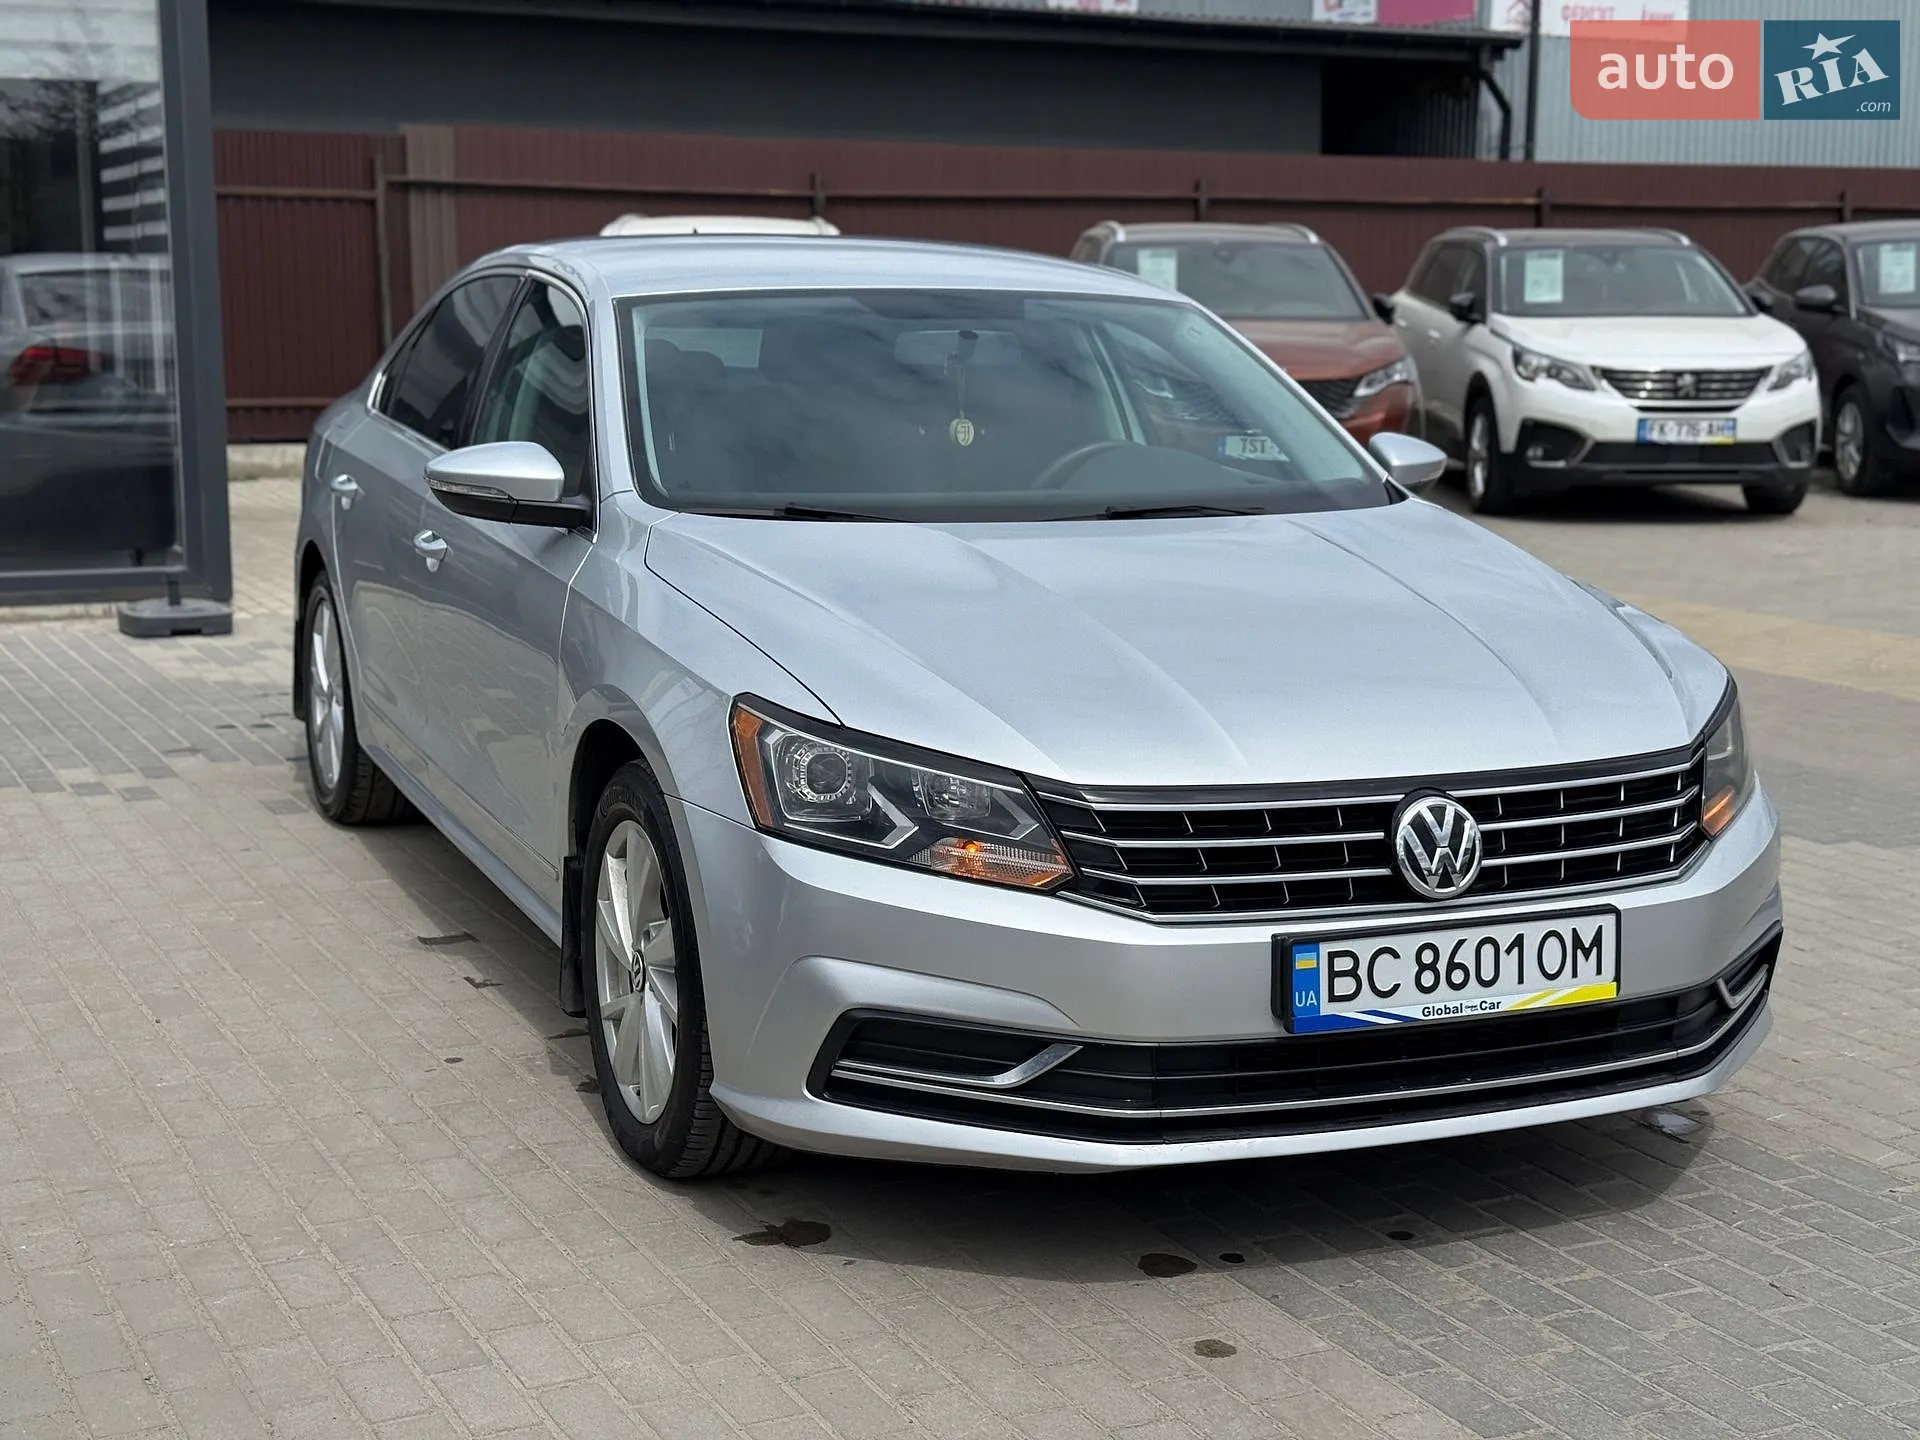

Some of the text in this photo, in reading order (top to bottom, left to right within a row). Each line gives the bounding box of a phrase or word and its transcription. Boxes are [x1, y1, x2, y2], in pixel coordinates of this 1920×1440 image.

[1327, 924, 1603, 1003] BC 8601 OM
[1295, 990, 1318, 1007] UA
[1421, 1002, 1463, 1017] Global
[1479, 1000, 1502, 1011] Car
